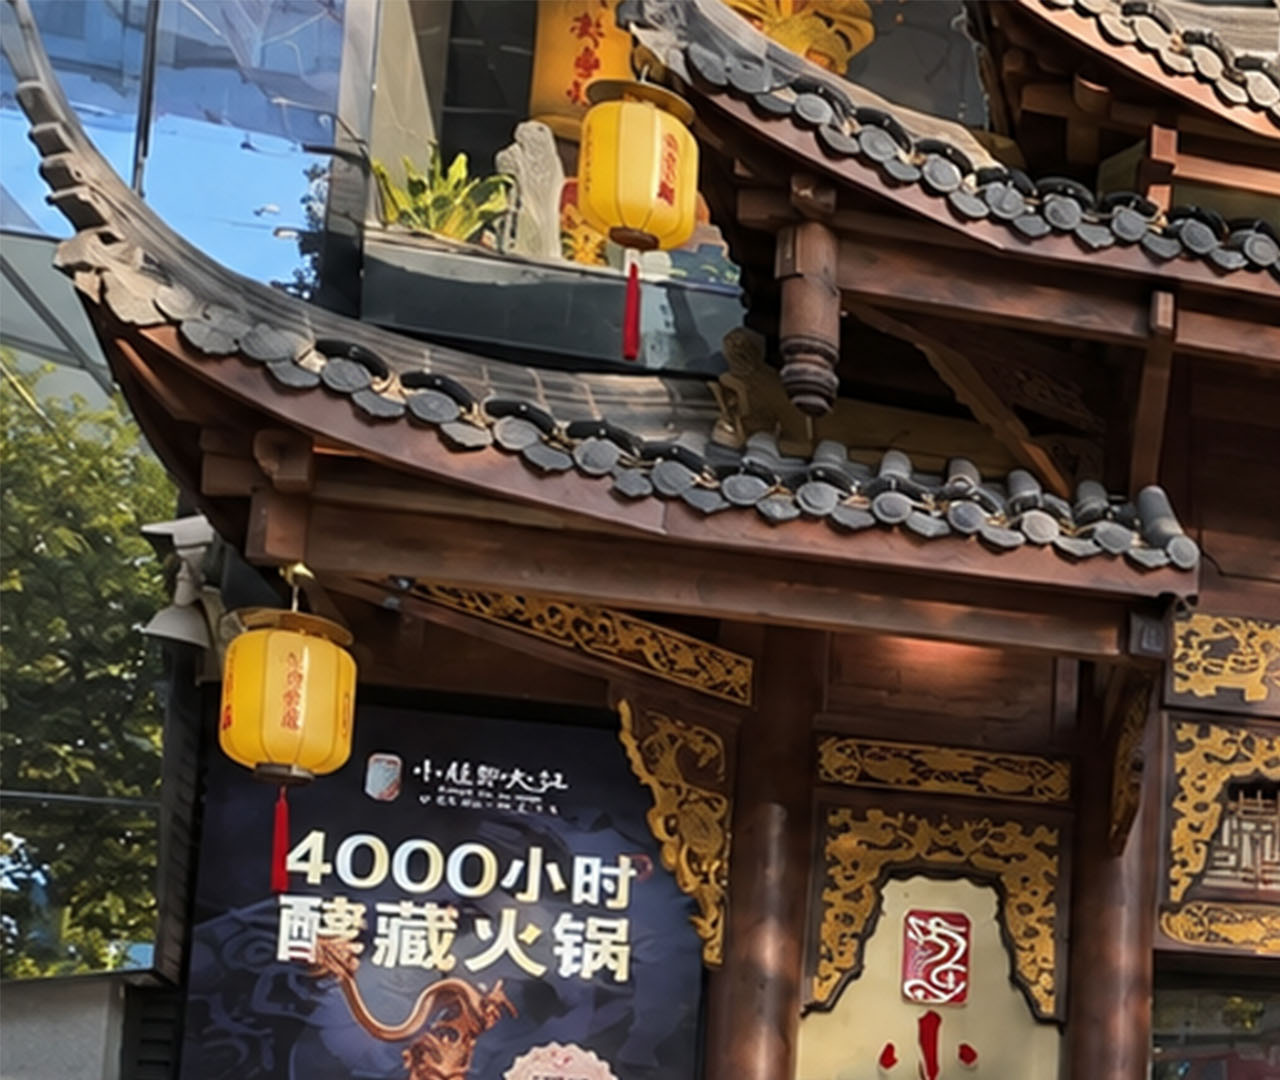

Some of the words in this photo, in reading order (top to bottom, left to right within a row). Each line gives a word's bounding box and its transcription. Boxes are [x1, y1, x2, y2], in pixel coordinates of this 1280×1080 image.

[285, 830, 637, 910] 4000小时
[276, 894, 632, 982] 酵藏火锅
